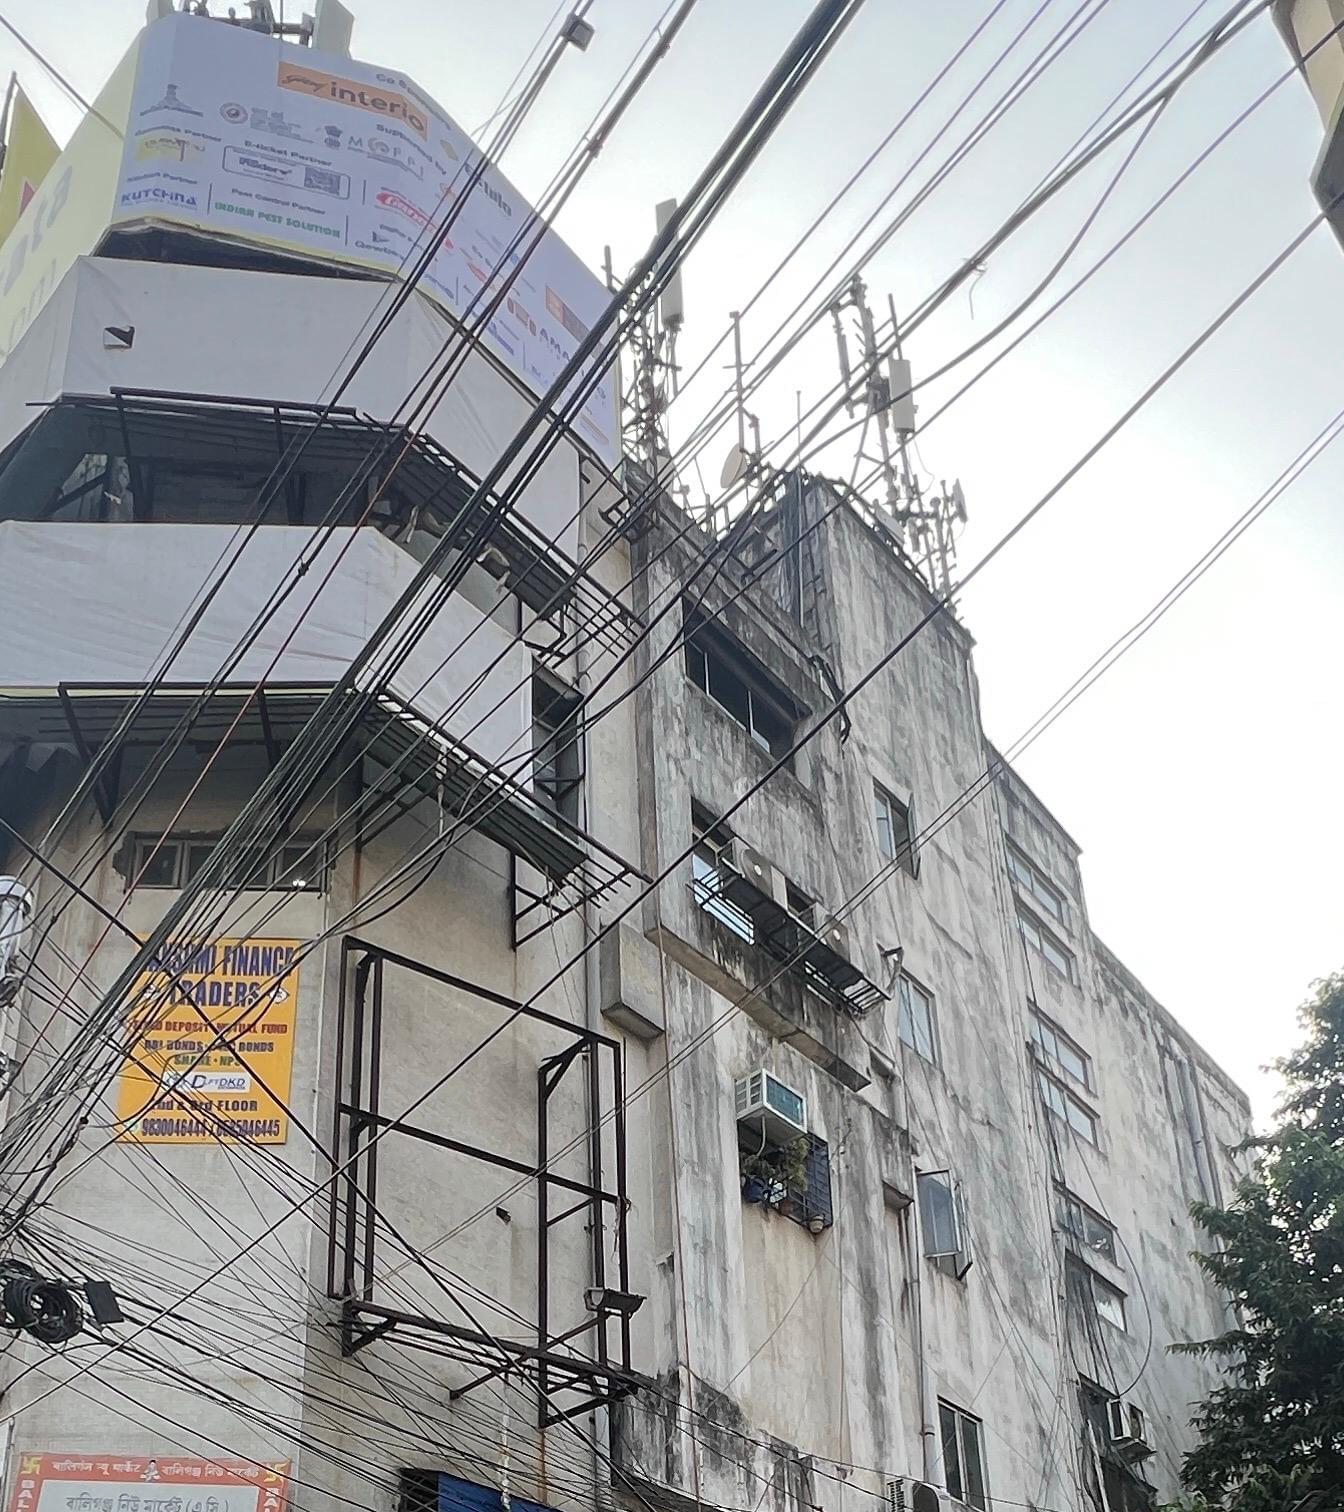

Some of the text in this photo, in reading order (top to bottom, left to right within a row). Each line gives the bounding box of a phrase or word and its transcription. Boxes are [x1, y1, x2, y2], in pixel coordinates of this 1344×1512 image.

[330, 82, 425, 132] interio
[258, 211, 282, 224] PEST
[286, 217, 341, 238] SOLUTION
[217, 1101, 258, 1111] FLOOR
[116, 1493, 141, 1512] নিউ
